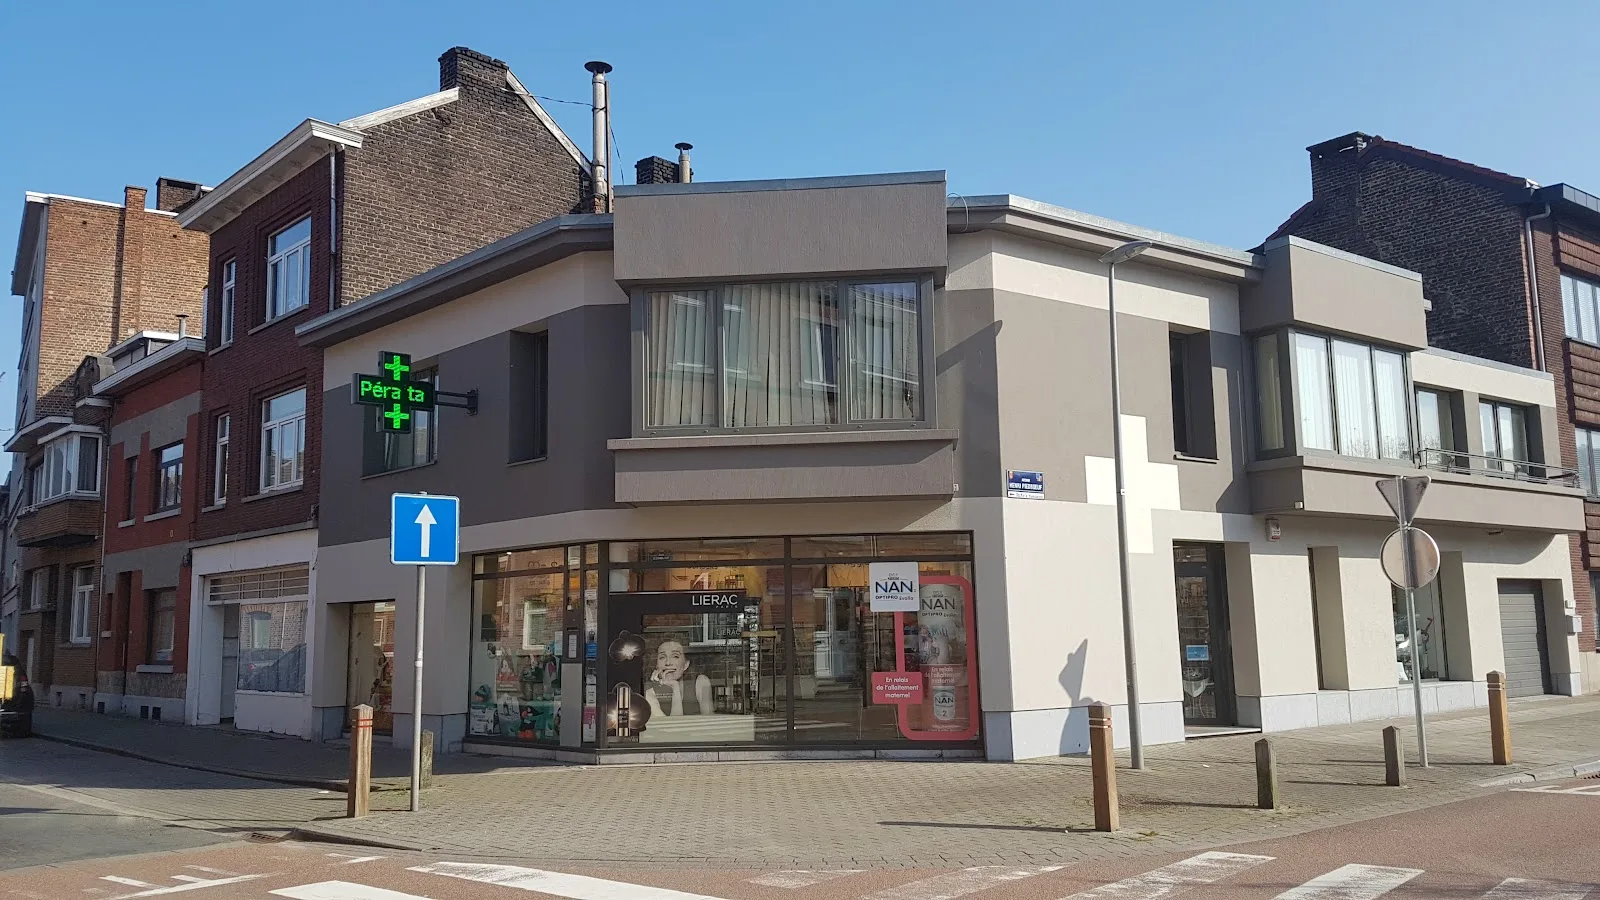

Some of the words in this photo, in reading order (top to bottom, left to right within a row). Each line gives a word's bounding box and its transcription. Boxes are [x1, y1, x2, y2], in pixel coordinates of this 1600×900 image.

[360, 380, 401, 400] Péra
[407, 385, 425, 403] ta
[875, 581, 913, 593] NAN
[692, 594, 738, 606] LIERAC
[921, 598, 955, 610] NAN
[716, 628, 741, 636] LIERAC
